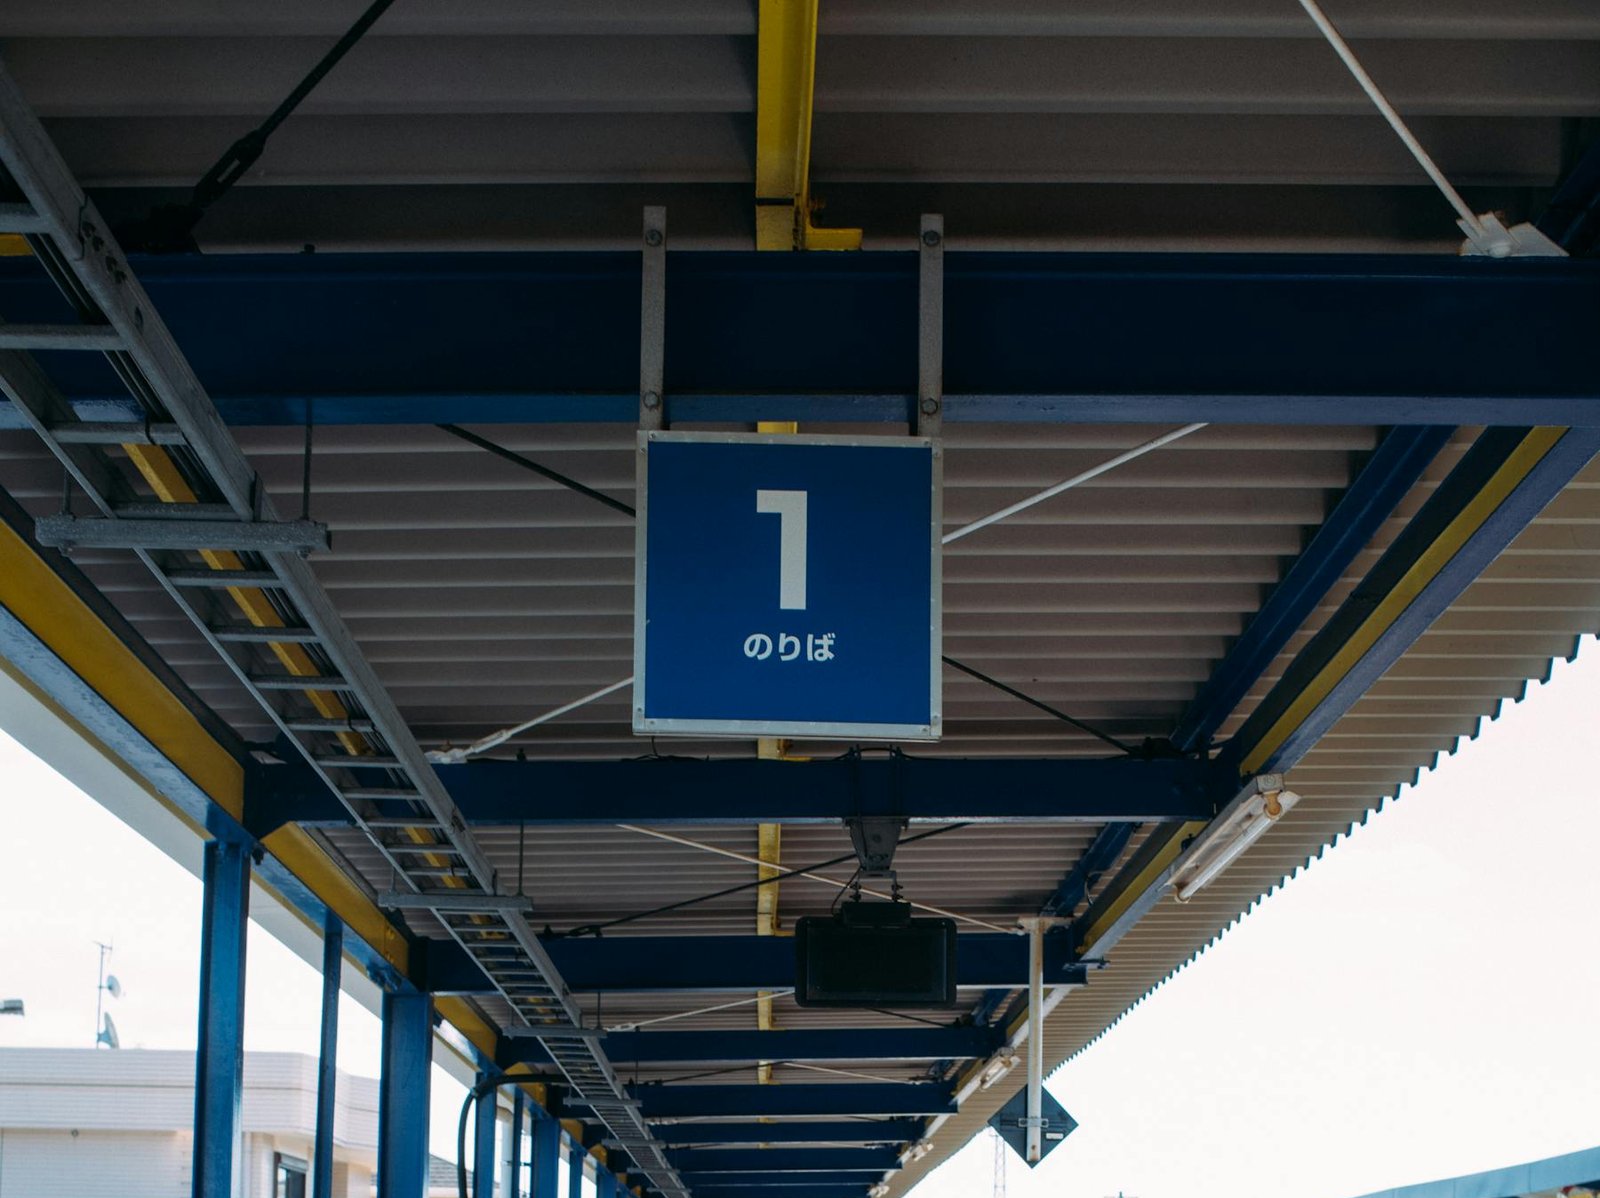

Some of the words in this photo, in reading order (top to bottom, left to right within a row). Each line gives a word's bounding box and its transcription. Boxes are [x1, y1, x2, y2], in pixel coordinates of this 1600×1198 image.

[756, 489, 808, 610] 1
[743, 632, 836, 662] のりば
